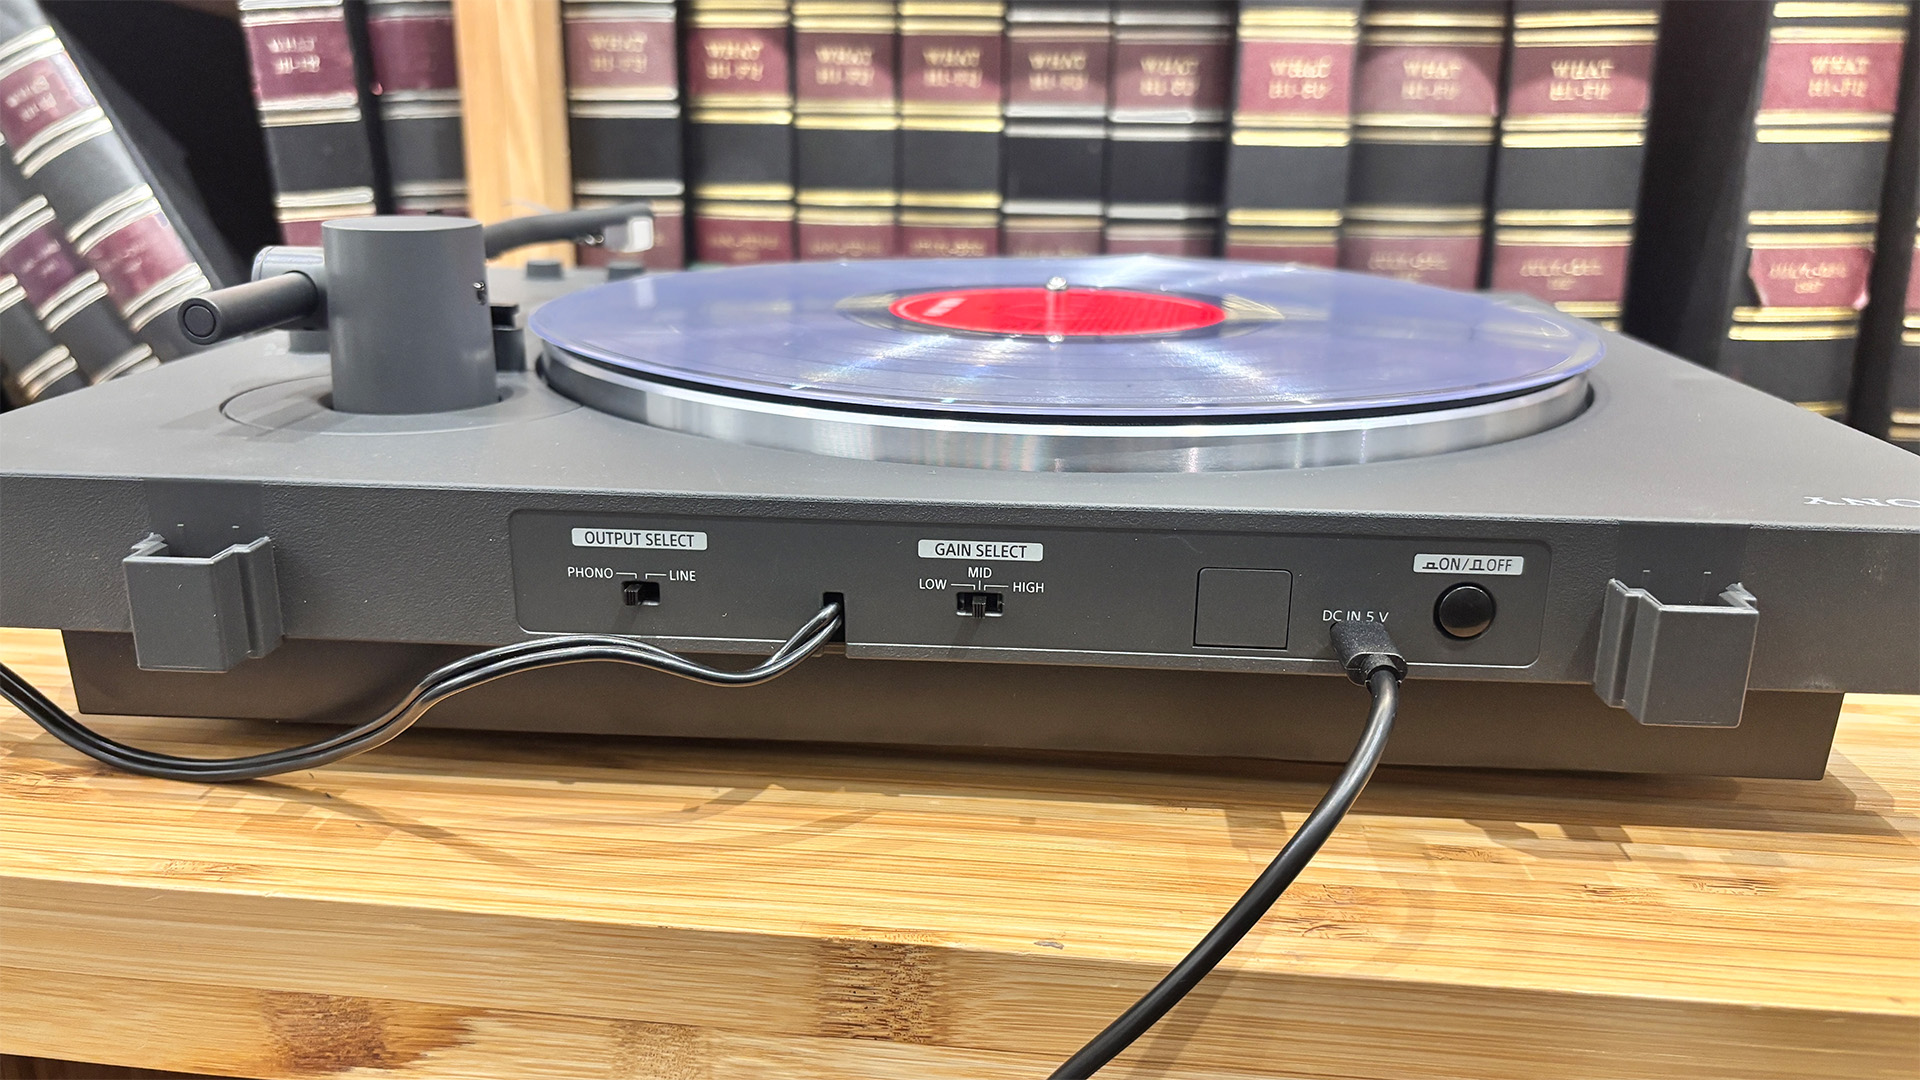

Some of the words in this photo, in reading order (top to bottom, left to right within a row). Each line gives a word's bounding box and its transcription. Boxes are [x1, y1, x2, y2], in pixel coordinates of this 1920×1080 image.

[584, 531, 641, 546] OUTPUT
[646, 533, 695, 547] SELECT
[935, 543, 971, 556] GAIN
[976, 544, 1027, 558] SELECT
[567, 567, 613, 579] PHONO
[669, 570, 696, 581] LINE
[968, 567, 992, 579] MID
[919, 578, 947, 590] LOW
[1013, 581, 1044, 593] HIGH
[1322, 609, 1342, 622] DC
[1347, 610, 1361, 622] IN
[1366, 611, 1375, 622] 5
[1379, 611, 1389, 623] V
